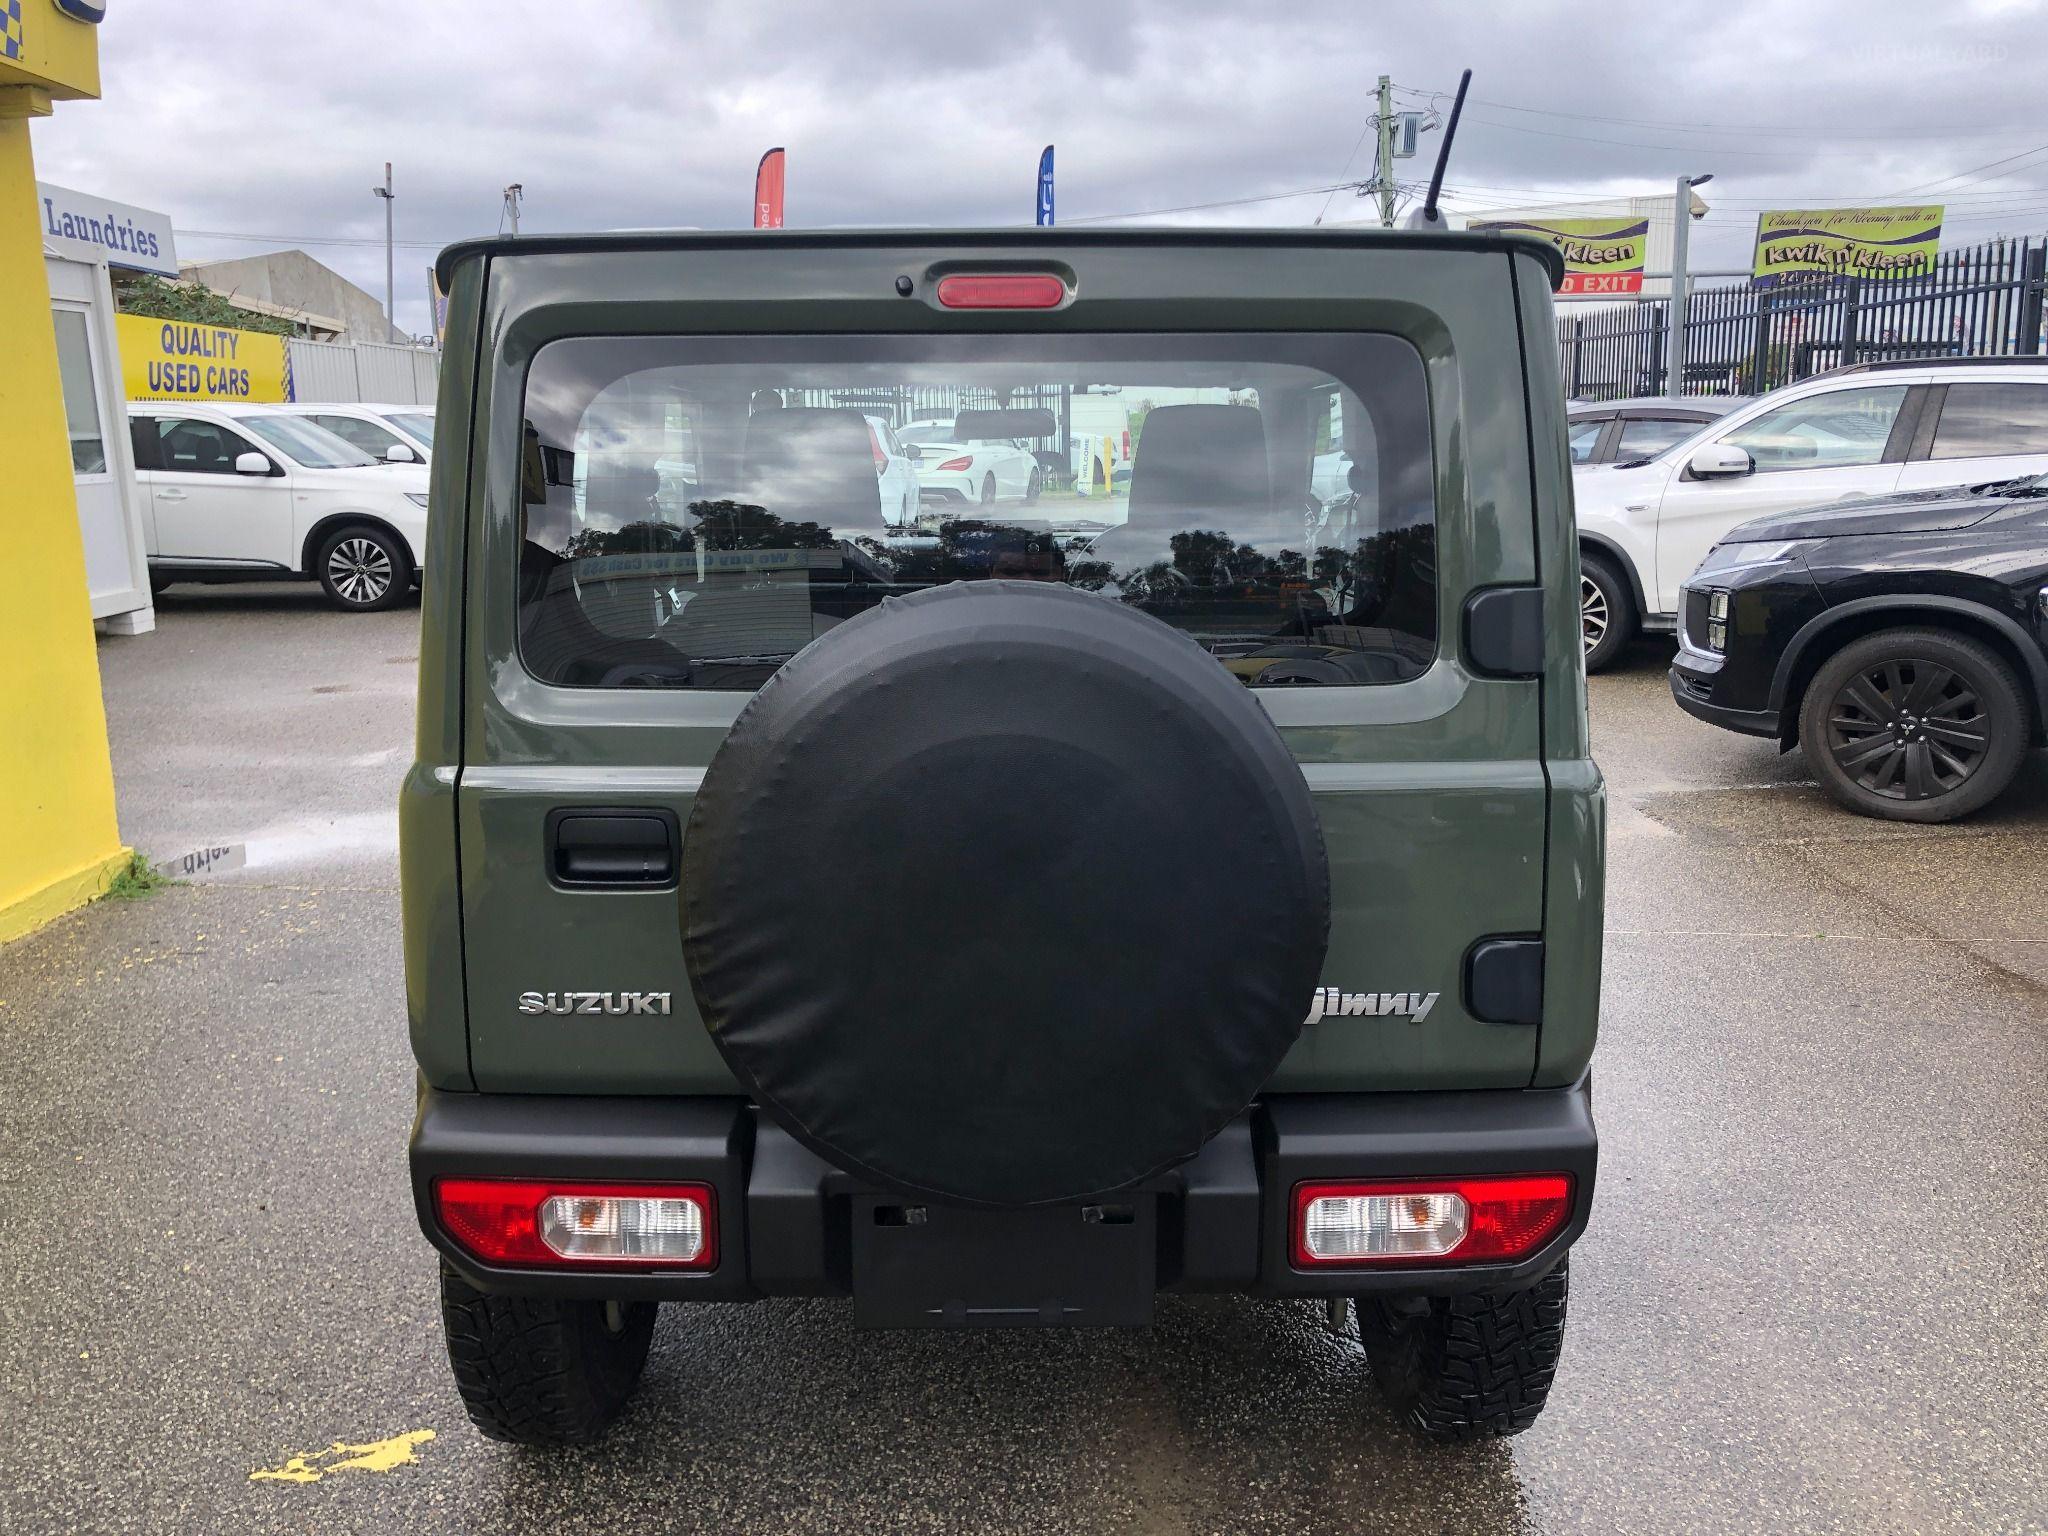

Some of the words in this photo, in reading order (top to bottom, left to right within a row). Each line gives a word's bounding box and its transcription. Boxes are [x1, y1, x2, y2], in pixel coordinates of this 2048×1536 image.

[43, 198, 159, 258] Laundries
[1799, 218, 1823, 233] you
[1825, 211, 1847, 229] for
[1897, 207, 1924, 222] with
[1923, 213, 1937, 221] us
[1563, 241, 1636, 264] kleen
[1766, 242, 1829, 266] kwik
[1852, 249, 1928, 270] kleen
[1583, 276, 1632, 292] EXIT
[161, 323, 239, 360] QUALITY
[148, 361, 200, 393] USED
[206, 365, 249, 396] CARS
[1082, 438, 1090, 479] WELCOME
[518, 991, 672, 1015] SUZUKI
